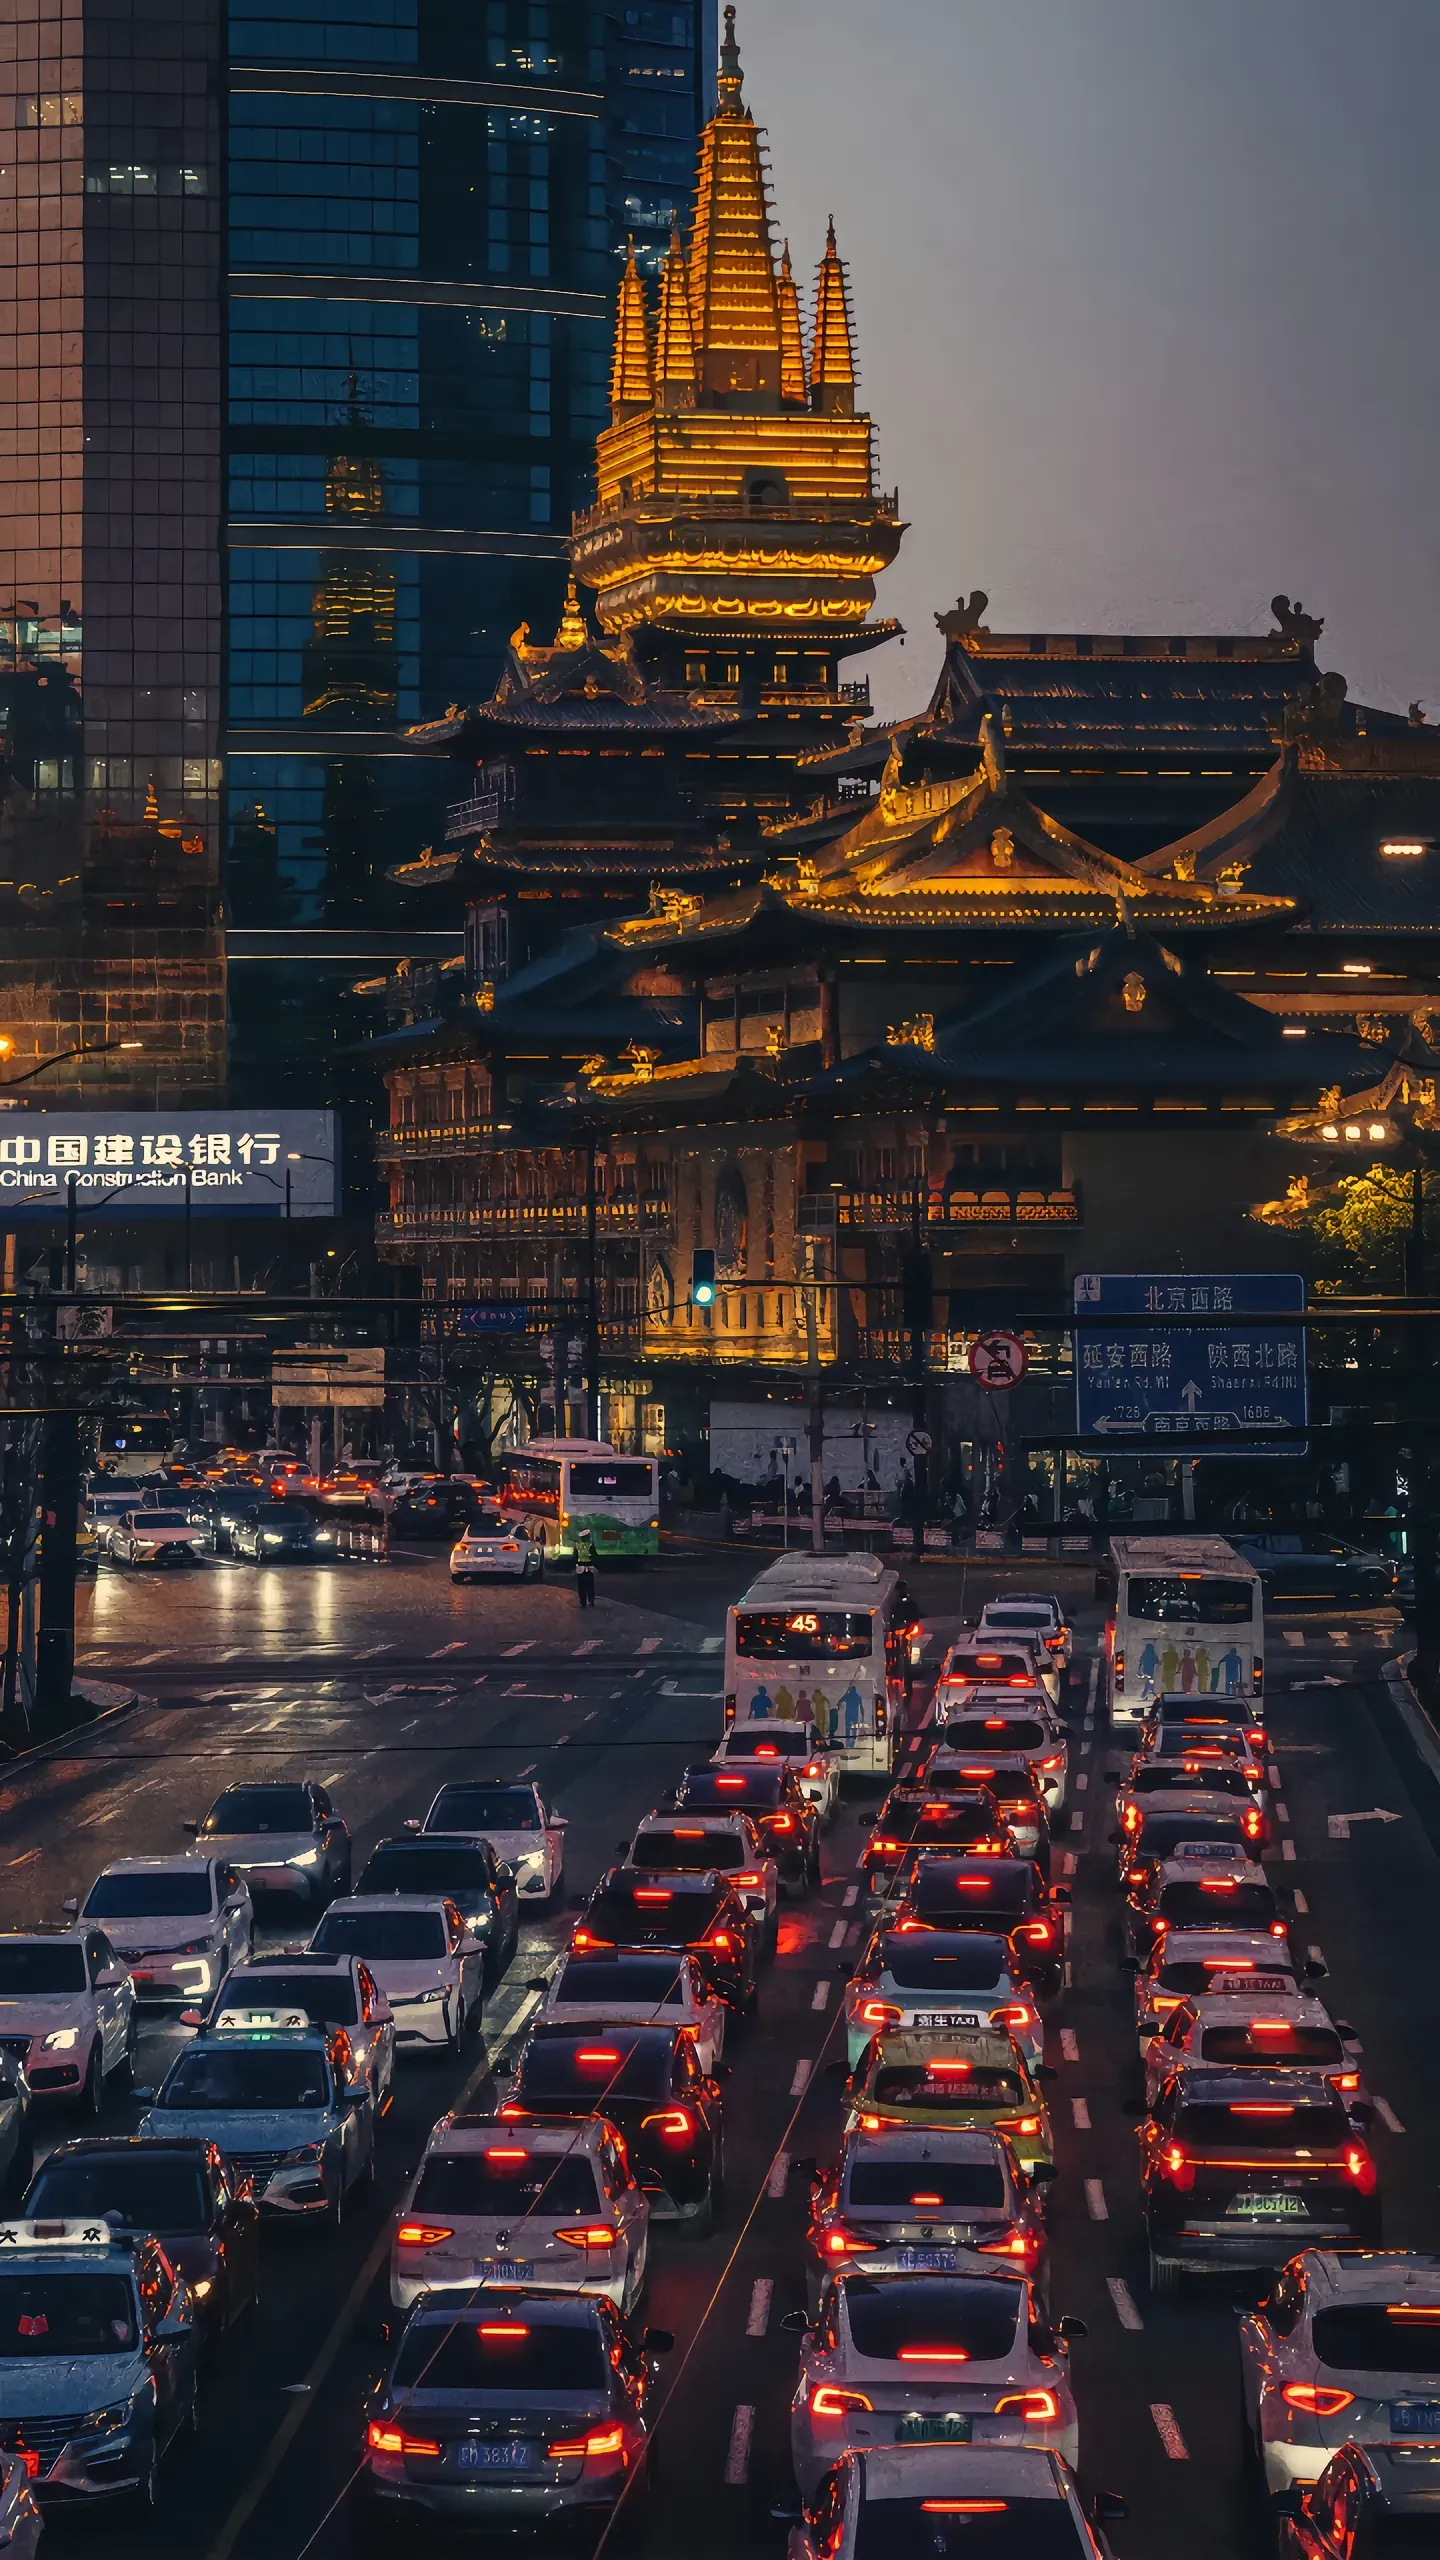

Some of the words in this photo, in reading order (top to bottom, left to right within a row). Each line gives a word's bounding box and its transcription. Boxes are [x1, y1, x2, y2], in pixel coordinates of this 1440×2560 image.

[0, 1133, 281, 1167] 中国建设银行
[0, 1169, 57, 1188] China
[191, 1169, 244, 1187] Bank
[1144, 1285, 1233, 1311] 北京西路
[1083, 1342, 1172, 1369] 延安西路
[791, 1614, 818, 1632] 45
